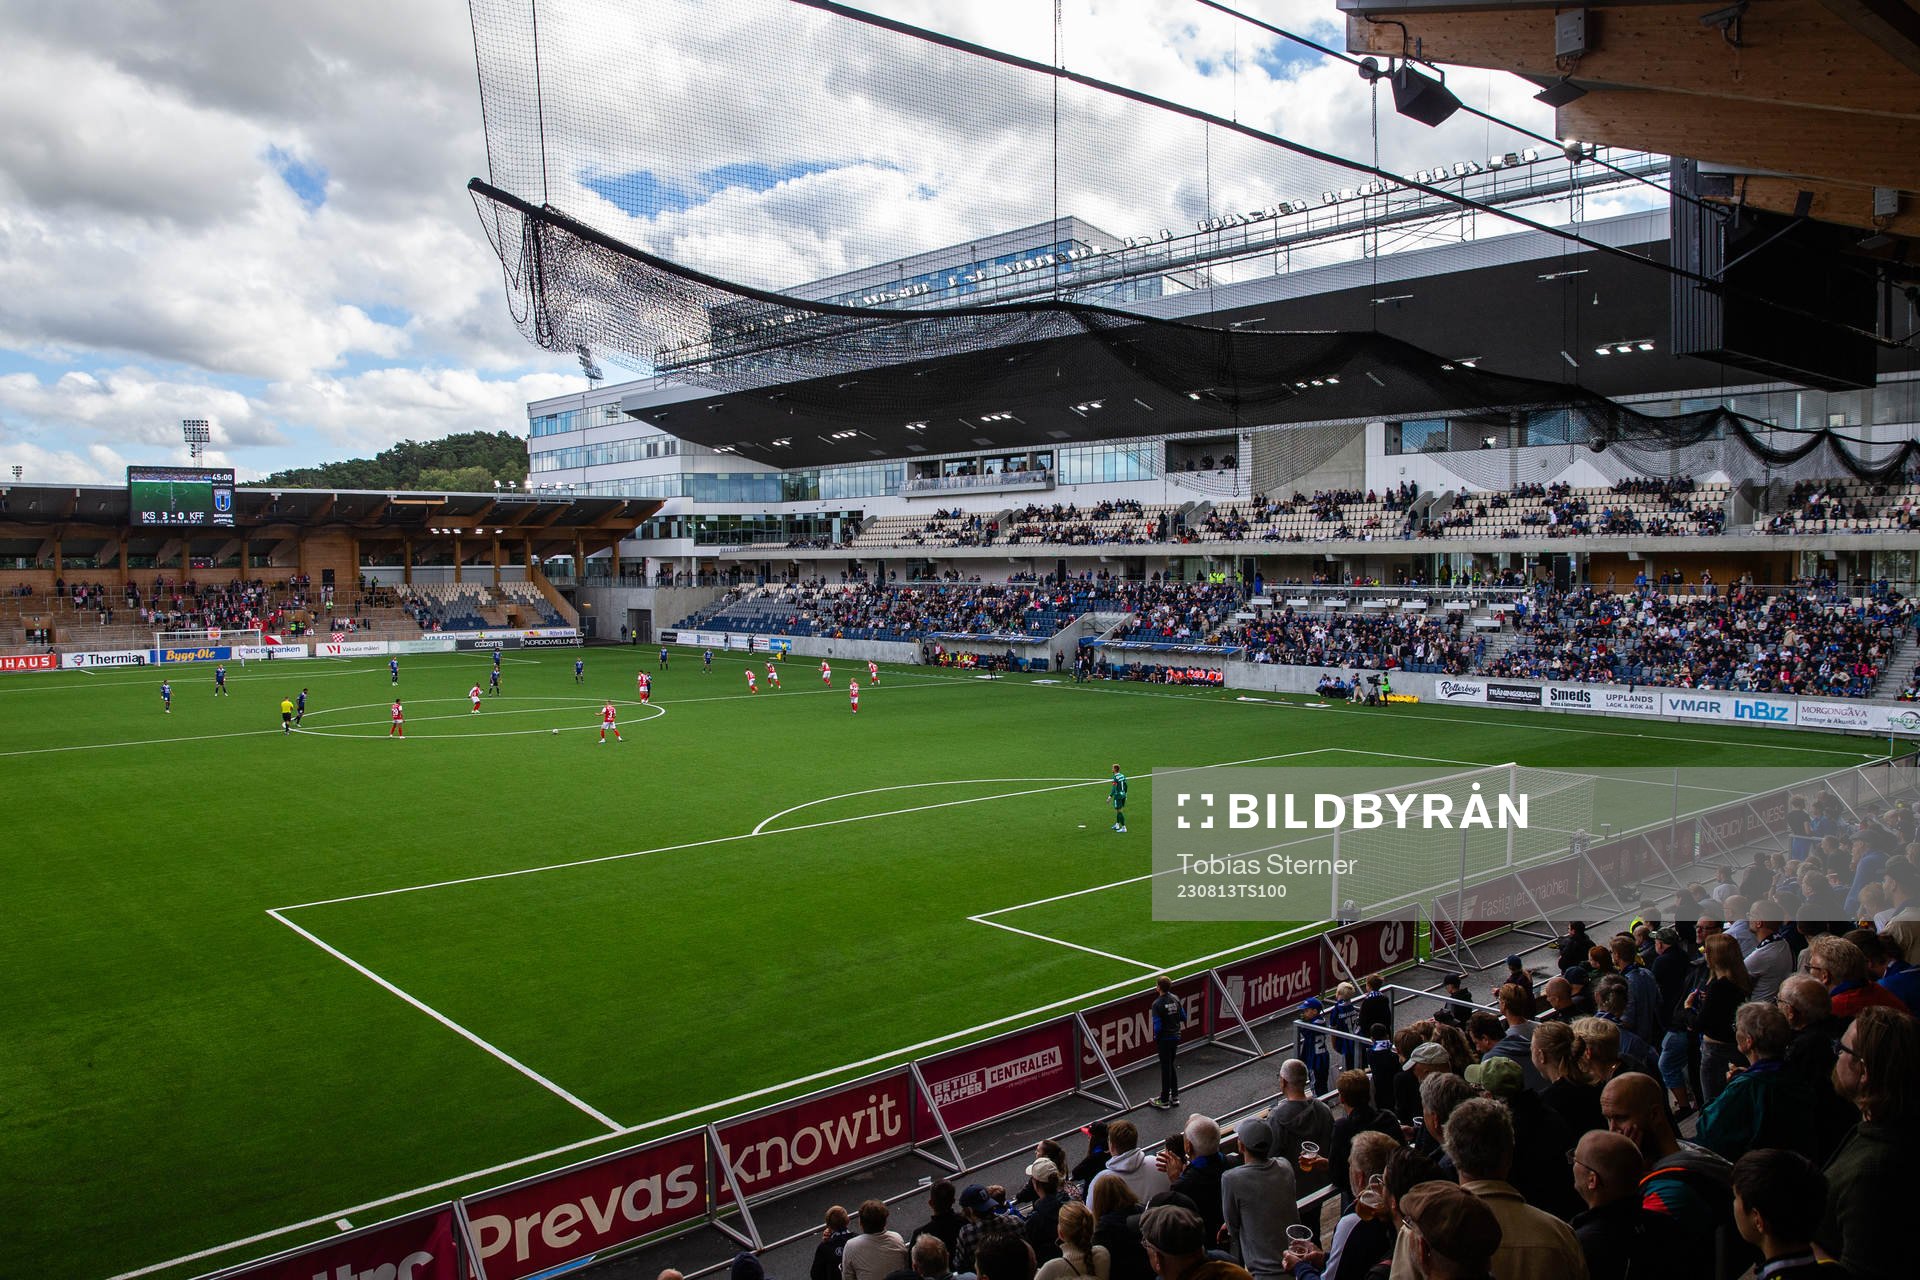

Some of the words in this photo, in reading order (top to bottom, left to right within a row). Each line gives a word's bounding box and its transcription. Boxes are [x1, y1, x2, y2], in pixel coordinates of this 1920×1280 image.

[142, 512, 156, 520] IKS
[162, 512, 168, 520] 3
[177, 512, 185, 520] 0
[189, 512, 205, 520] KFF
[88, 652, 140, 665] Thermia
[1440, 681, 1481, 695] Rollerboys
[1550, 687, 1591, 703] Smeds
[1606, 693, 1654, 703] UPPLANDS
[1669, 699, 1721, 714] VMAR
[1802, 706, 1868, 718] MORGONGÅVA
[1248, 961, 1311, 1008] Tidtryck
[1083, 993, 1200, 1065] SERNE
[990, 1050, 1057, 1084] CENTRALEN
[933, 1072, 978, 1096] RETUR
[934, 1082, 983, 1107] PAPPER
[721, 1093, 902, 1193] knowit
[468, 1164, 699, 1279] Prevas
